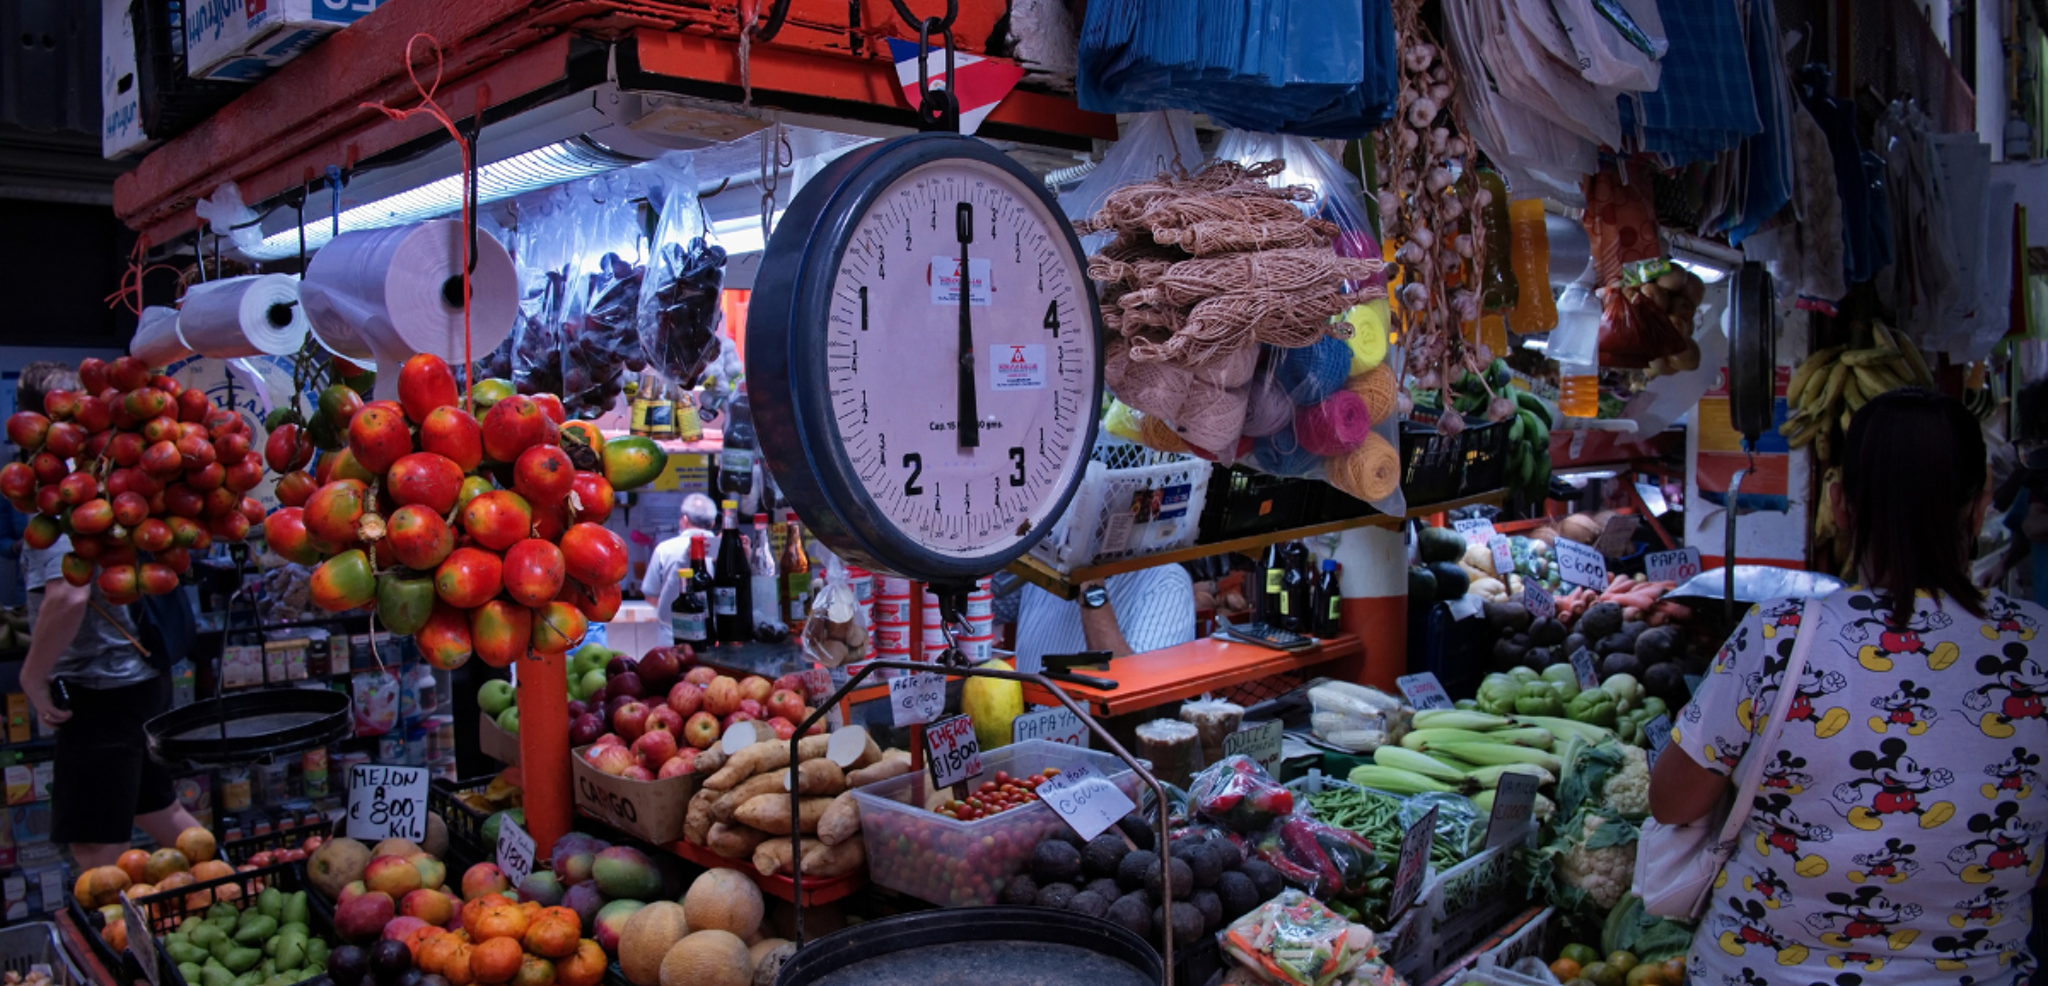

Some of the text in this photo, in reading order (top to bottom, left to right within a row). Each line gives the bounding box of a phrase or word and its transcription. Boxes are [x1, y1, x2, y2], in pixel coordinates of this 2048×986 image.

[956, 202, 973, 244] 0
[858, 285, 868, 331] 1
[1043, 300, 1061, 338] 4
[902, 452, 923, 496] 2
[1009, 446, 1026, 487] 3
[1651, 551, 1688, 567] PAPA
[928, 718, 974, 750] CHERRY
[1018, 710, 1077, 742] PAPAYA
[352, 768, 418, 789] MELON
[374, 785, 386, 800] A
[579, 775, 637, 823] CARGO
